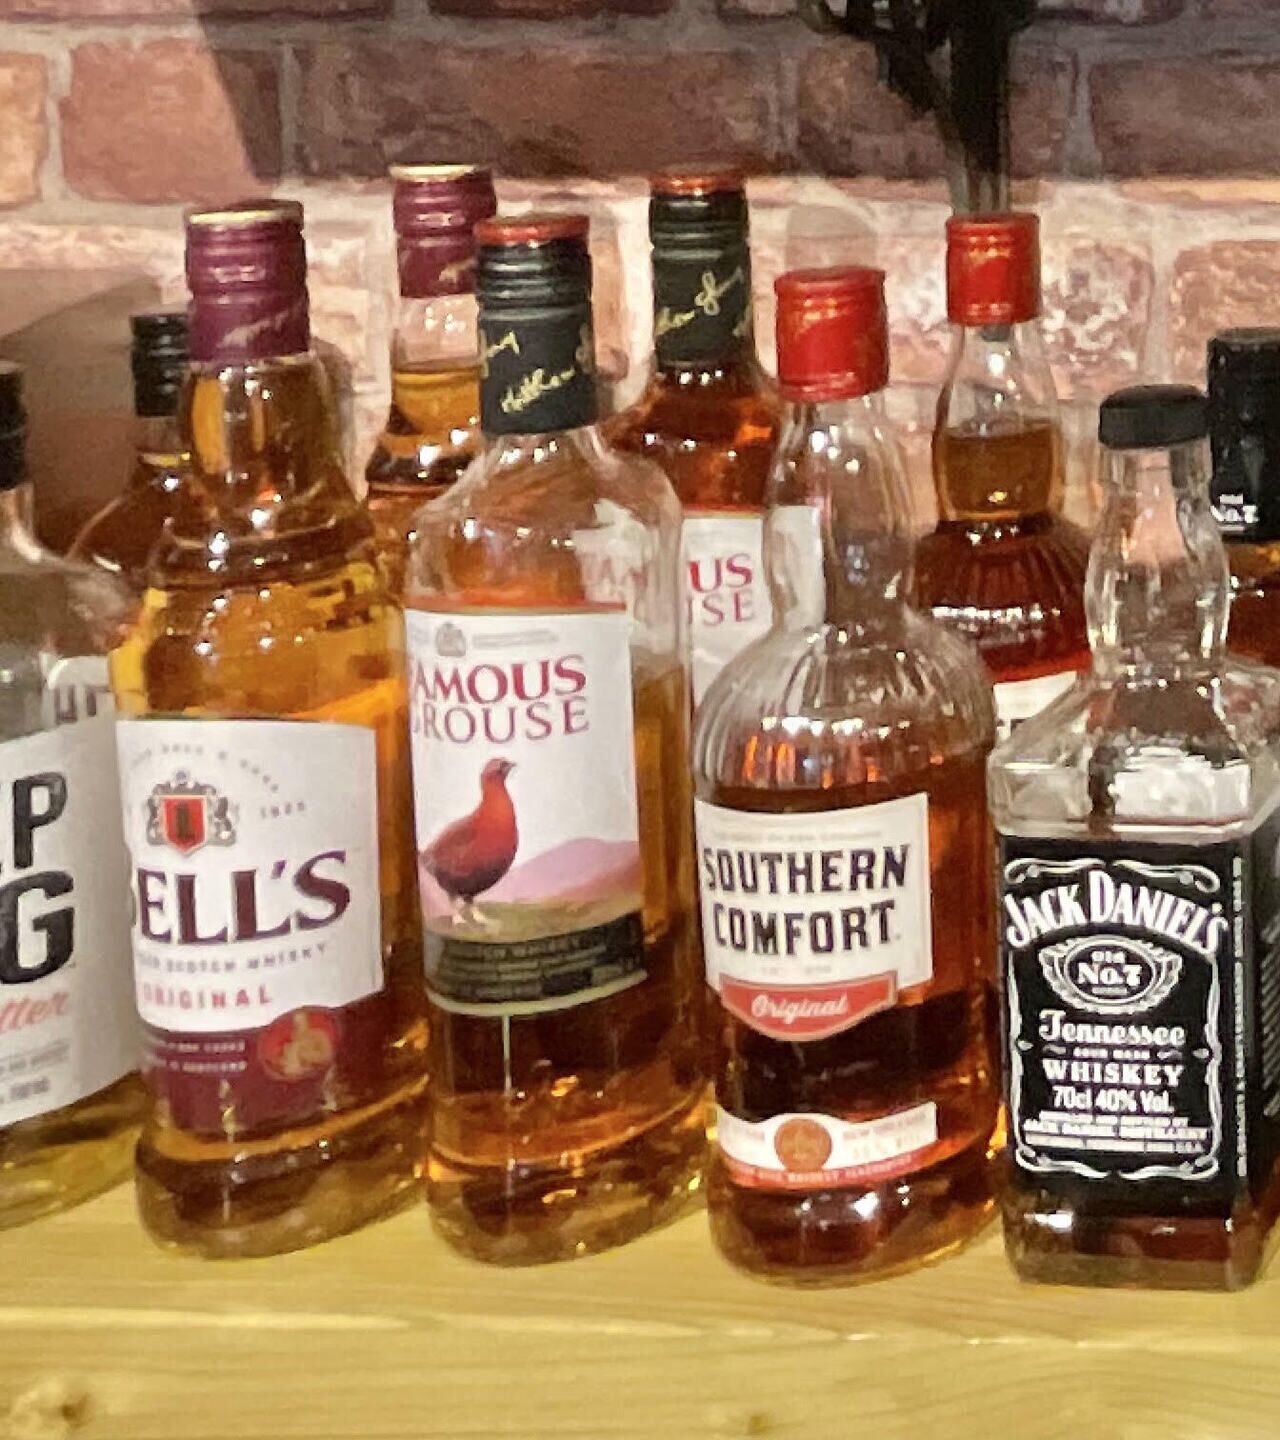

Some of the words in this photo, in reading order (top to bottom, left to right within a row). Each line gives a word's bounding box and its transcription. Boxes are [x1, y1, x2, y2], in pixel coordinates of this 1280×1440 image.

[13, 771, 68, 870] P
[703, 842, 911, 895] SOUTHERN
[713, 899, 896, 956] COMFORT
[1003, 884, 1088, 950] JACK
[1087, 868, 1230, 955] DANIEL'S
[142, 982, 272, 1011] ORIGINAL
[750, 992, 850, 1024] Original
[1038, 1008, 1186, 1046] Tennessee
[1042, 1058, 1185, 1088] WHISKEY
[1052, 1085, 1093, 1110] 70cl
[1094, 1087, 1137, 1112] 40%
